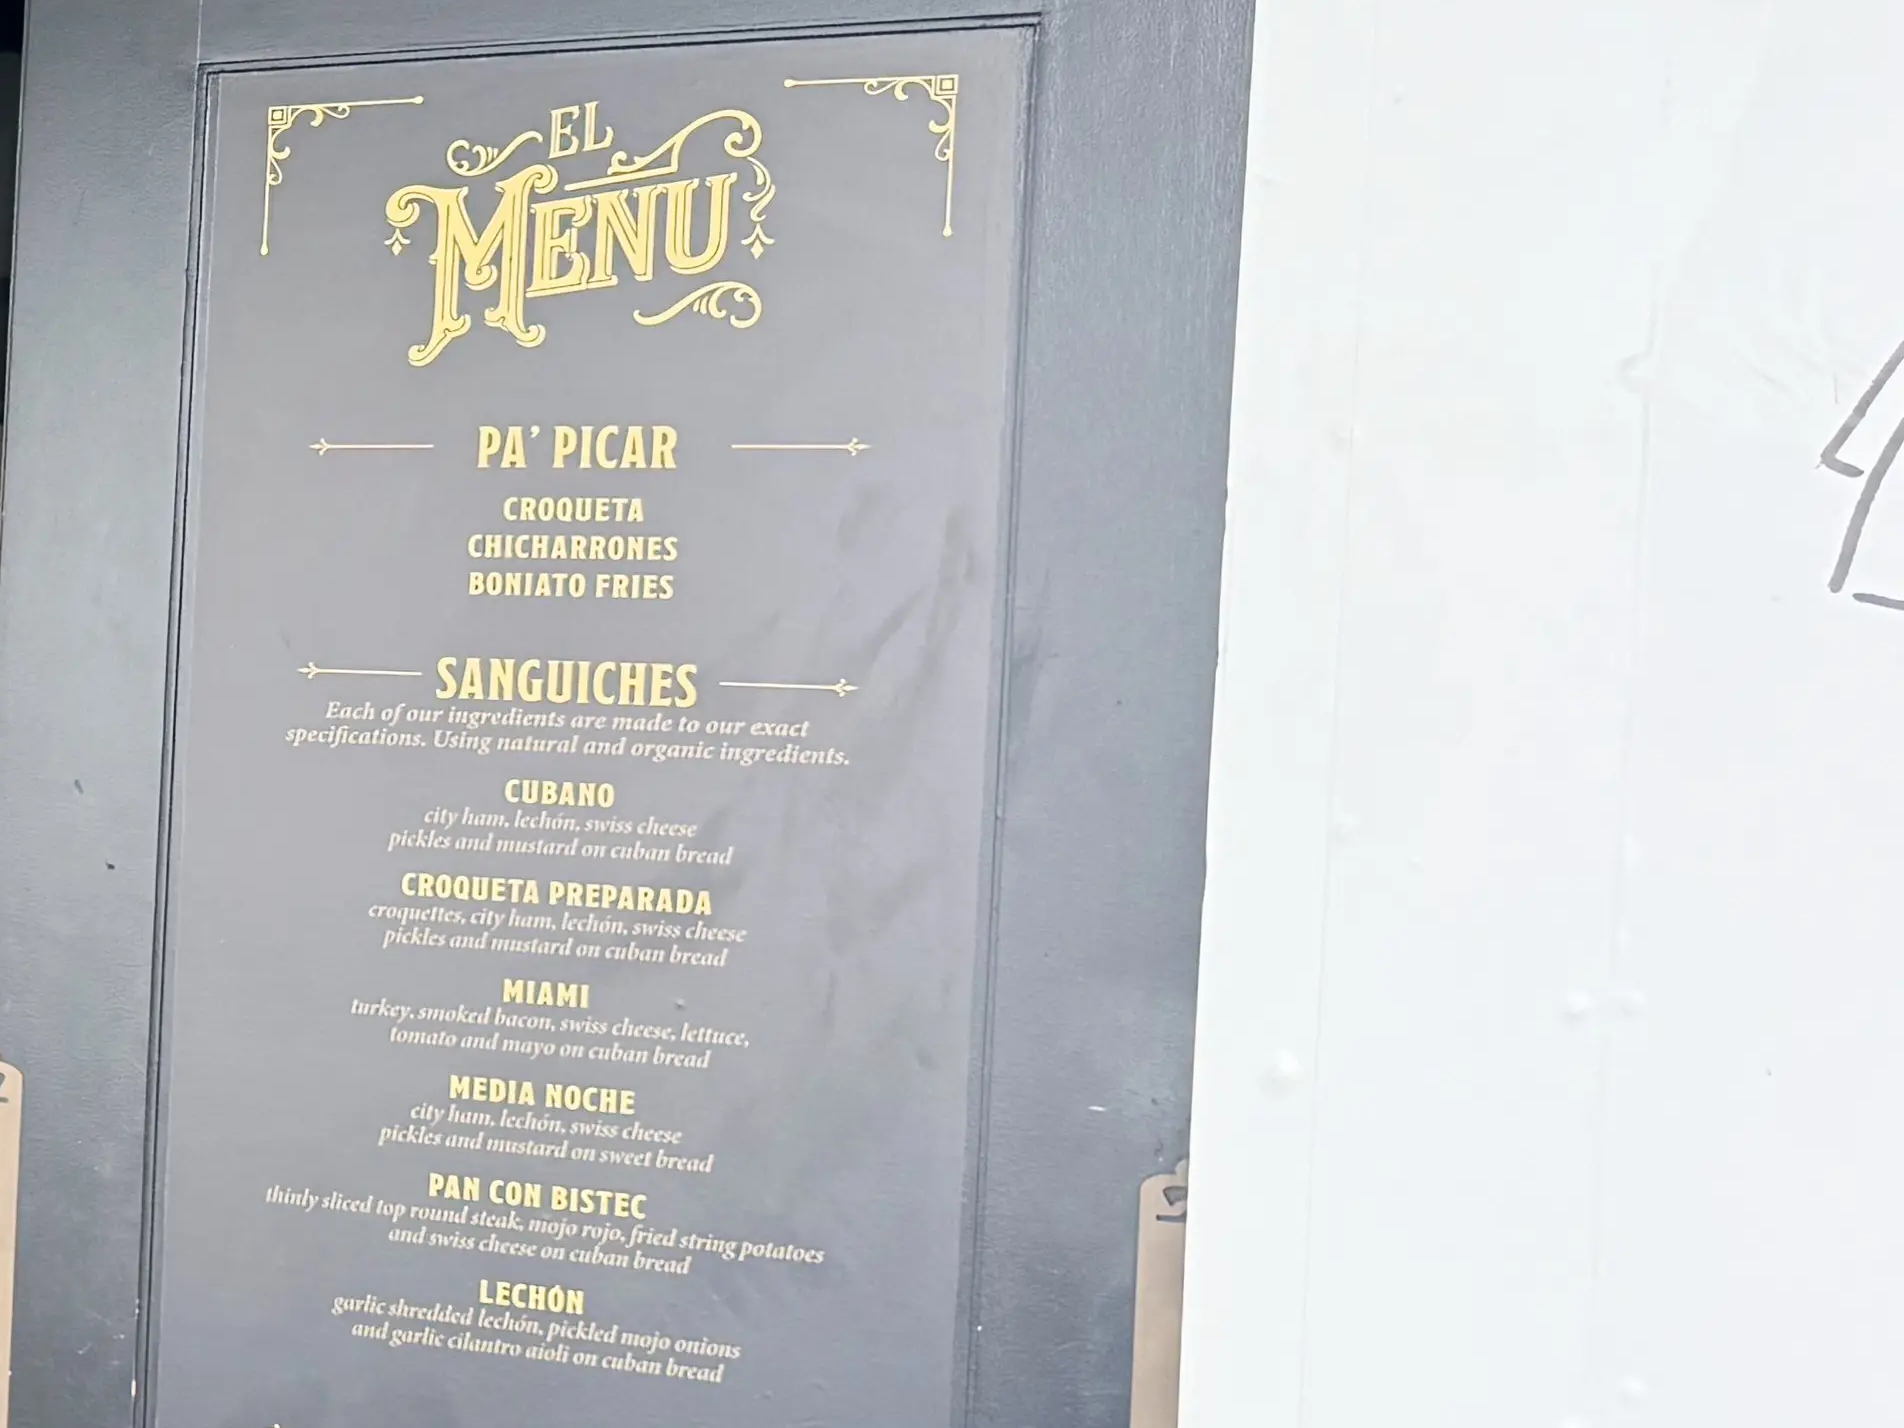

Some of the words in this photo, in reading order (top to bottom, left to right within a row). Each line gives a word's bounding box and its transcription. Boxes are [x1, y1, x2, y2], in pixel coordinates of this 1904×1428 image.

[548, 101, 614, 160] EL
[384, 164, 739, 368] MENU
[476, 424, 541, 469] PA'
[551, 424, 678, 470] PICAR
[502, 495, 644, 523] CROQUETA
[467, 532, 679, 562] CHICHARRONES
[467, 570, 586, 598] BONIATO
[594, 573, 674, 600] FRIES
[434, 655, 698, 708] SANGUICHES
[324, 699, 375, 722] Each
[380, 702, 408, 727] of
[405, 708, 445, 723] our
[447, 704, 566, 730] ingredients
[569, 714, 608, 730] are
[610, 711, 673, 732] made
[677, 715, 701, 733] to
[704, 719, 747, 736] our
[749, 719, 811, 738] exact
[284, 724, 427, 749] specifications.
[433, 728, 493, 756] Using
[496, 733, 580, 754] natural
[582, 735, 628, 756] and
[629, 739, 716, 763] organic
[718, 740, 850, 766] ingredients.
[503, 777, 615, 808] CUBANO
[423, 805, 459, 830] city
[583, 815, 633, 835] swiss
[636, 815, 698, 838] cheese
[386, 828, 452, 853] pickles
[453, 831, 495, 852] and
[495, 836, 580, 856] mustard
[580, 843, 608, 859] on
[609, 839, 671, 862] cuban
[674, 842, 735, 866] bread
[400, 871, 540, 905] CROQUETA
[547, 879, 713, 916] PREPARADA
[468, 906, 506, 931] city
[630, 918, 682, 939] swiss
[684, 919, 748, 943] cheese
[501, 977, 590, 1009] MIAMI
[416, 1003, 492, 1025] smoked
[558, 1014, 609, 1035] swiss
[389, 1025, 458, 1047] tomato
[459, 1031, 500, 1051] and
[501, 1038, 556, 1059] mayo
[558, 1043, 585, 1058] on
[587, 1040, 649, 1064] cuban
[651, 1044, 713, 1069] bread
[448, 1073, 536, 1107] MEDIA
[544, 1082, 636, 1116] NOCHE
[427, 1171, 481, 1202] PAN
[488, 1178, 542, 1209] CON
[549, 1184, 648, 1220] BISTEC
[264, 1184, 320, 1213] thinly
[320, 1190, 374, 1214] sliced
[375, 1198, 407, 1223] top
[409, 1204, 470, 1225] round
[527, 1216, 579, 1241] mojo
[626, 1222, 679, 1249] fried
[677, 1232, 738, 1260] string
[735, 1240, 826, 1264] potatoes
[387, 1225, 427, 1245] and
[427, 1230, 476, 1250] swiss
[477, 1232, 538, 1257] cheese
[539, 1245, 566, 1261] on
[568, 1242, 632, 1269] cuban
[632, 1248, 693, 1275] bread
[478, 1277, 585, 1316] LECHÓN
[330, 1295, 390, 1324] garlic
[387, 1299, 475, 1326] shredded
[545, 1318, 620, 1344] pickled
[619, 1330, 672, 1354] mojo
[673, 1335, 742, 1360] onions
[350, 1320, 391, 1346] and
[389, 1325, 445, 1348] garlic
[446, 1330, 522, 1357] cilantro
[524, 1338, 571, 1364] aioli
[571, 1351, 599, 1367] on
[600, 1350, 662, 1376] cuban
[665, 1356, 725, 1383] bread
